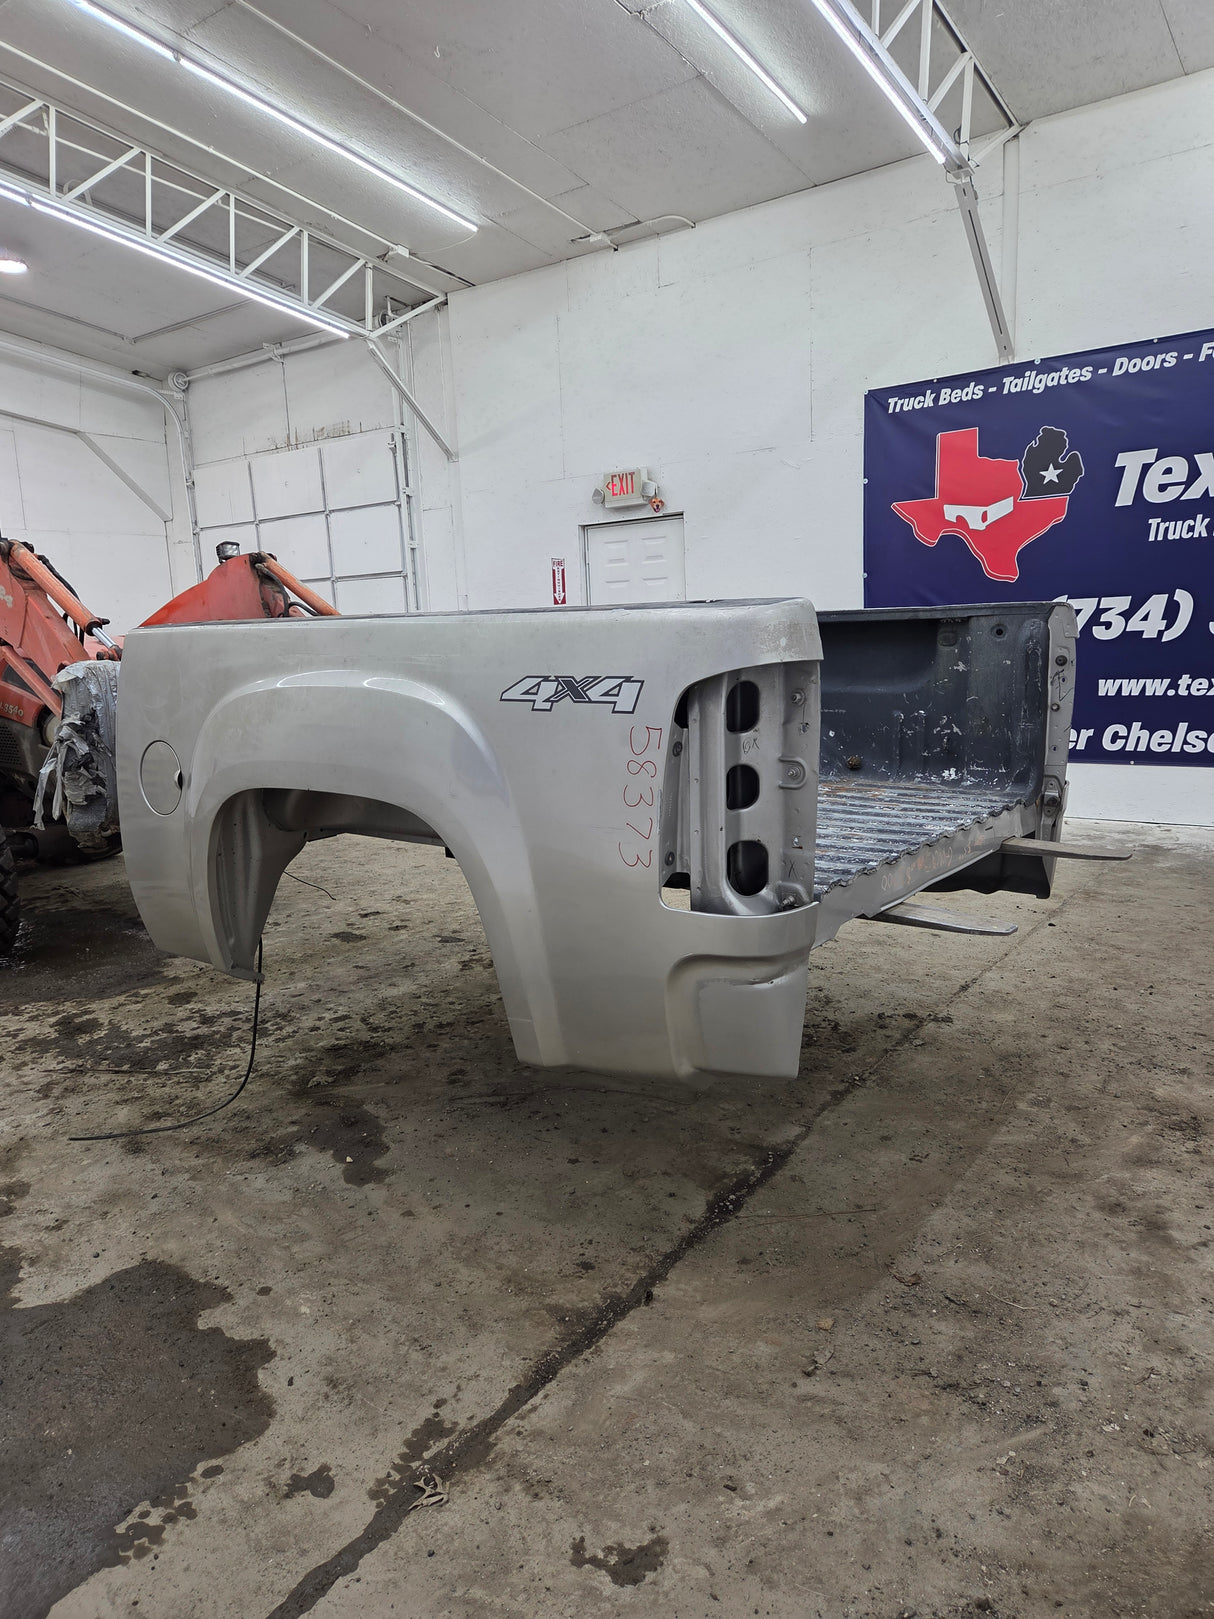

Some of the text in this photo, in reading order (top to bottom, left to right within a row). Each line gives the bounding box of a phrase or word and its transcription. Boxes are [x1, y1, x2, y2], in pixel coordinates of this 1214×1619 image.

[887, 390, 936, 414] Truck
[938, 382, 984, 406] Beds
[1002, 364, 1093, 394] Tailgates
[1112, 350, 1178, 376] Doors
[610, 471, 635, 497] EXIT
[1148, 514, 1211, 542] Truck
[1052, 588, 1194, 642] 734)
[618, 725, 663, 869] 58373
